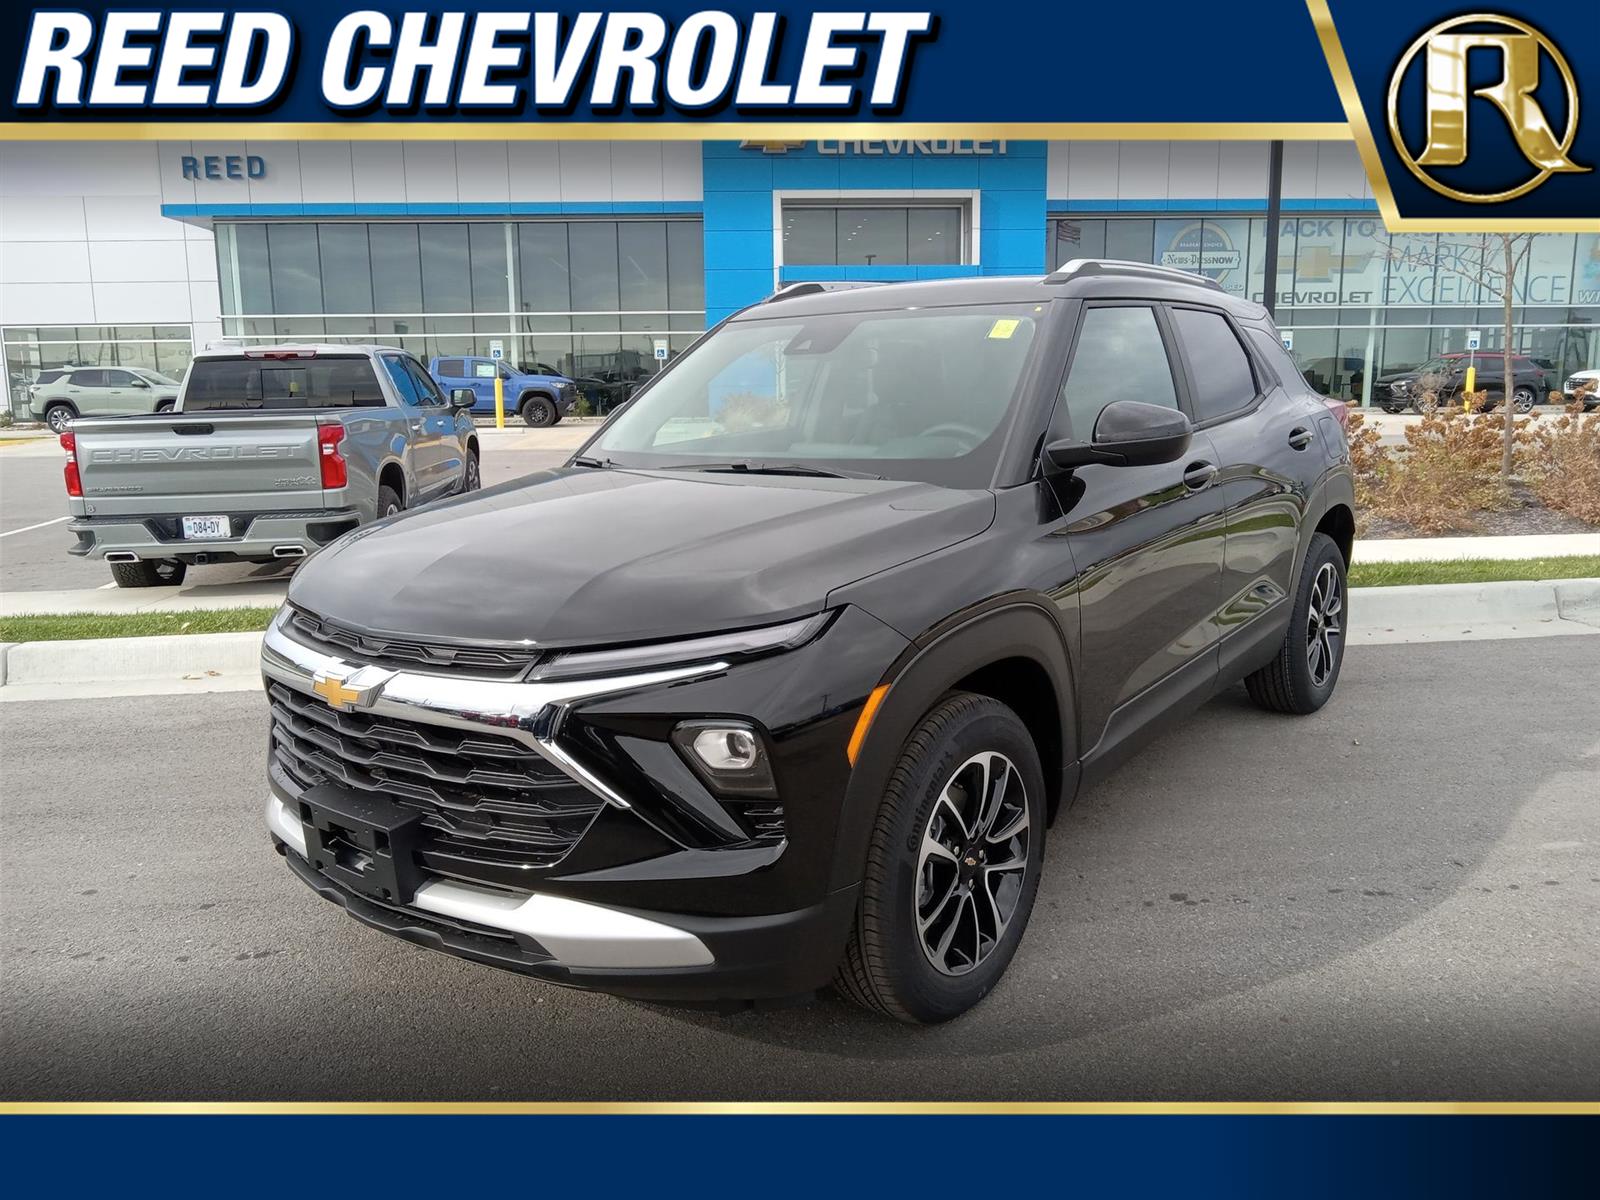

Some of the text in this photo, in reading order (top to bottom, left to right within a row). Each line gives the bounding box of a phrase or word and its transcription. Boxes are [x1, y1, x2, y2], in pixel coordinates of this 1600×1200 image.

[816, 140, 1008, 155] CHEVROLET
[181, 155, 265, 179] REED
[1263, 220, 1334, 238] ACK
[1383, 244, 1470, 272] MARK
[1252, 291, 1373, 304] CEVROLET
[91, 444, 302, 463] CHEVROLET
